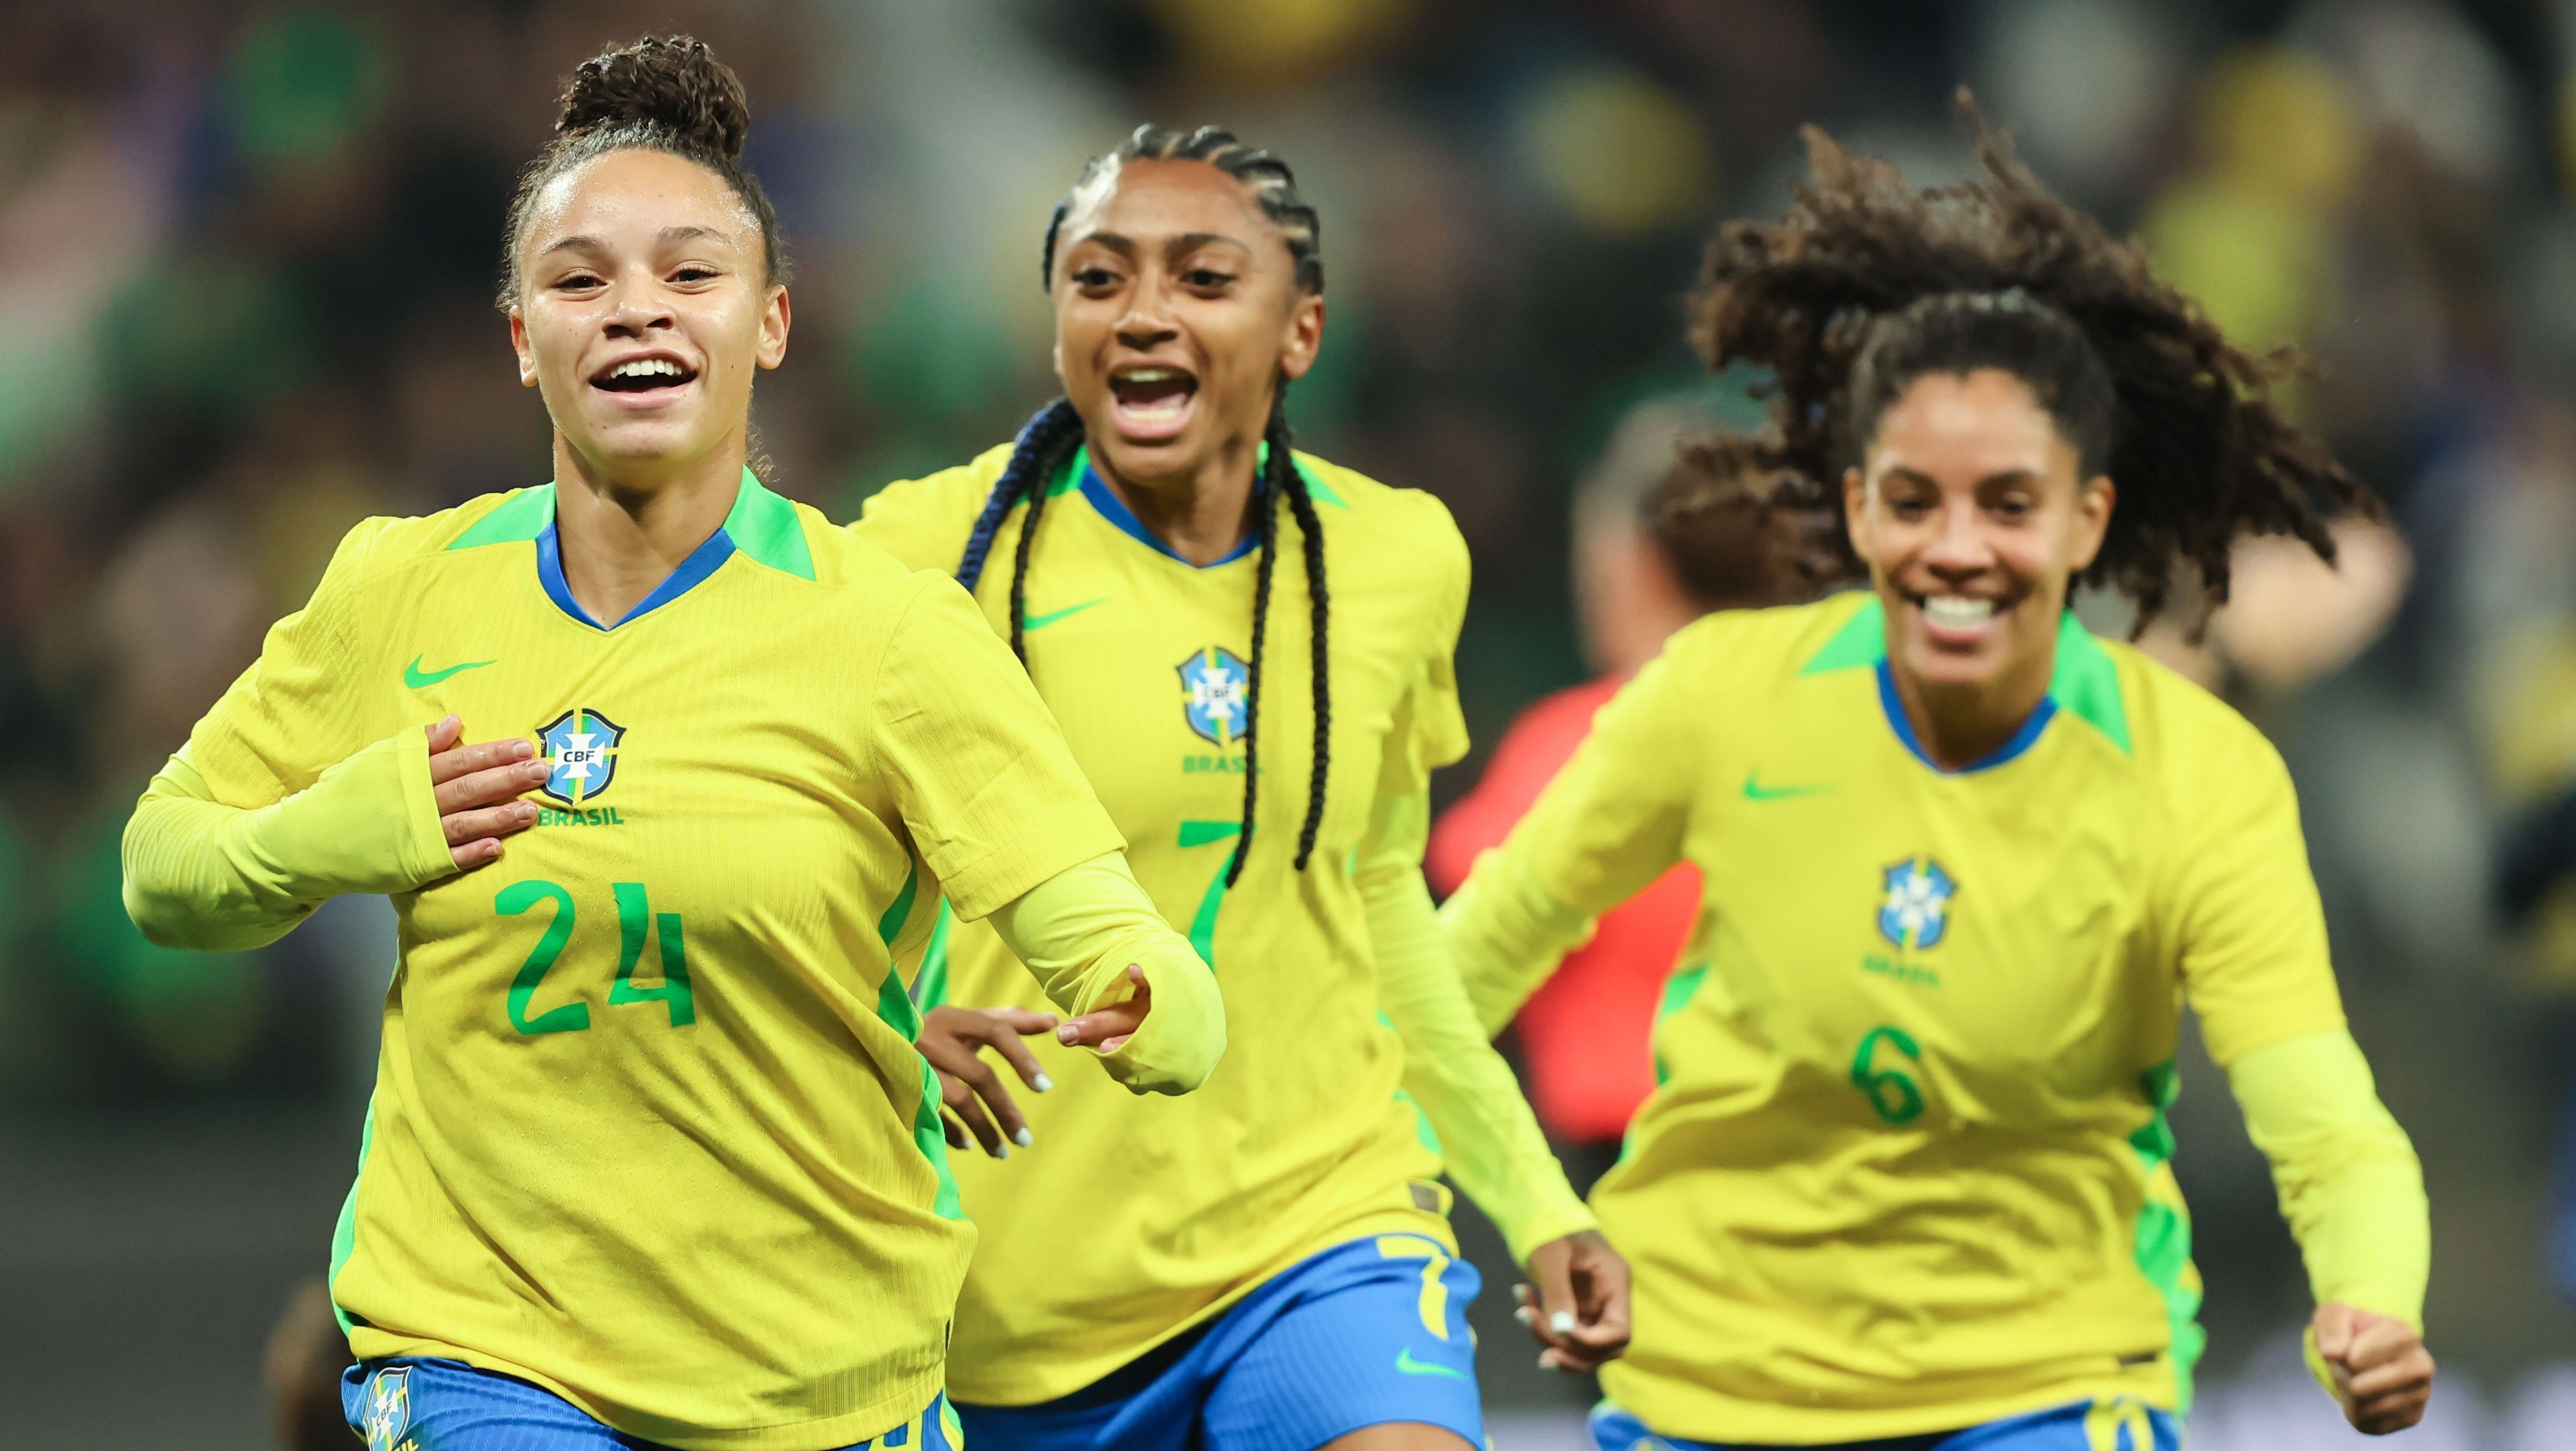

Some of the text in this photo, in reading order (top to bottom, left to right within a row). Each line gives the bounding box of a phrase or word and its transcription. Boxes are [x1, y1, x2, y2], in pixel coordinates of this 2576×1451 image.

[564, 750, 595, 762] CBF
[1182, 755, 1266, 774] BRAS
[538, 806, 625, 826] BRASIL
[1178, 819, 1255, 975] 7
[495, 879, 696, 1035] 24
[1850, 1025, 1926, 1126] 6
[1375, 1234, 1450, 1342] 7
[376, 1401, 392, 1427] CBF
